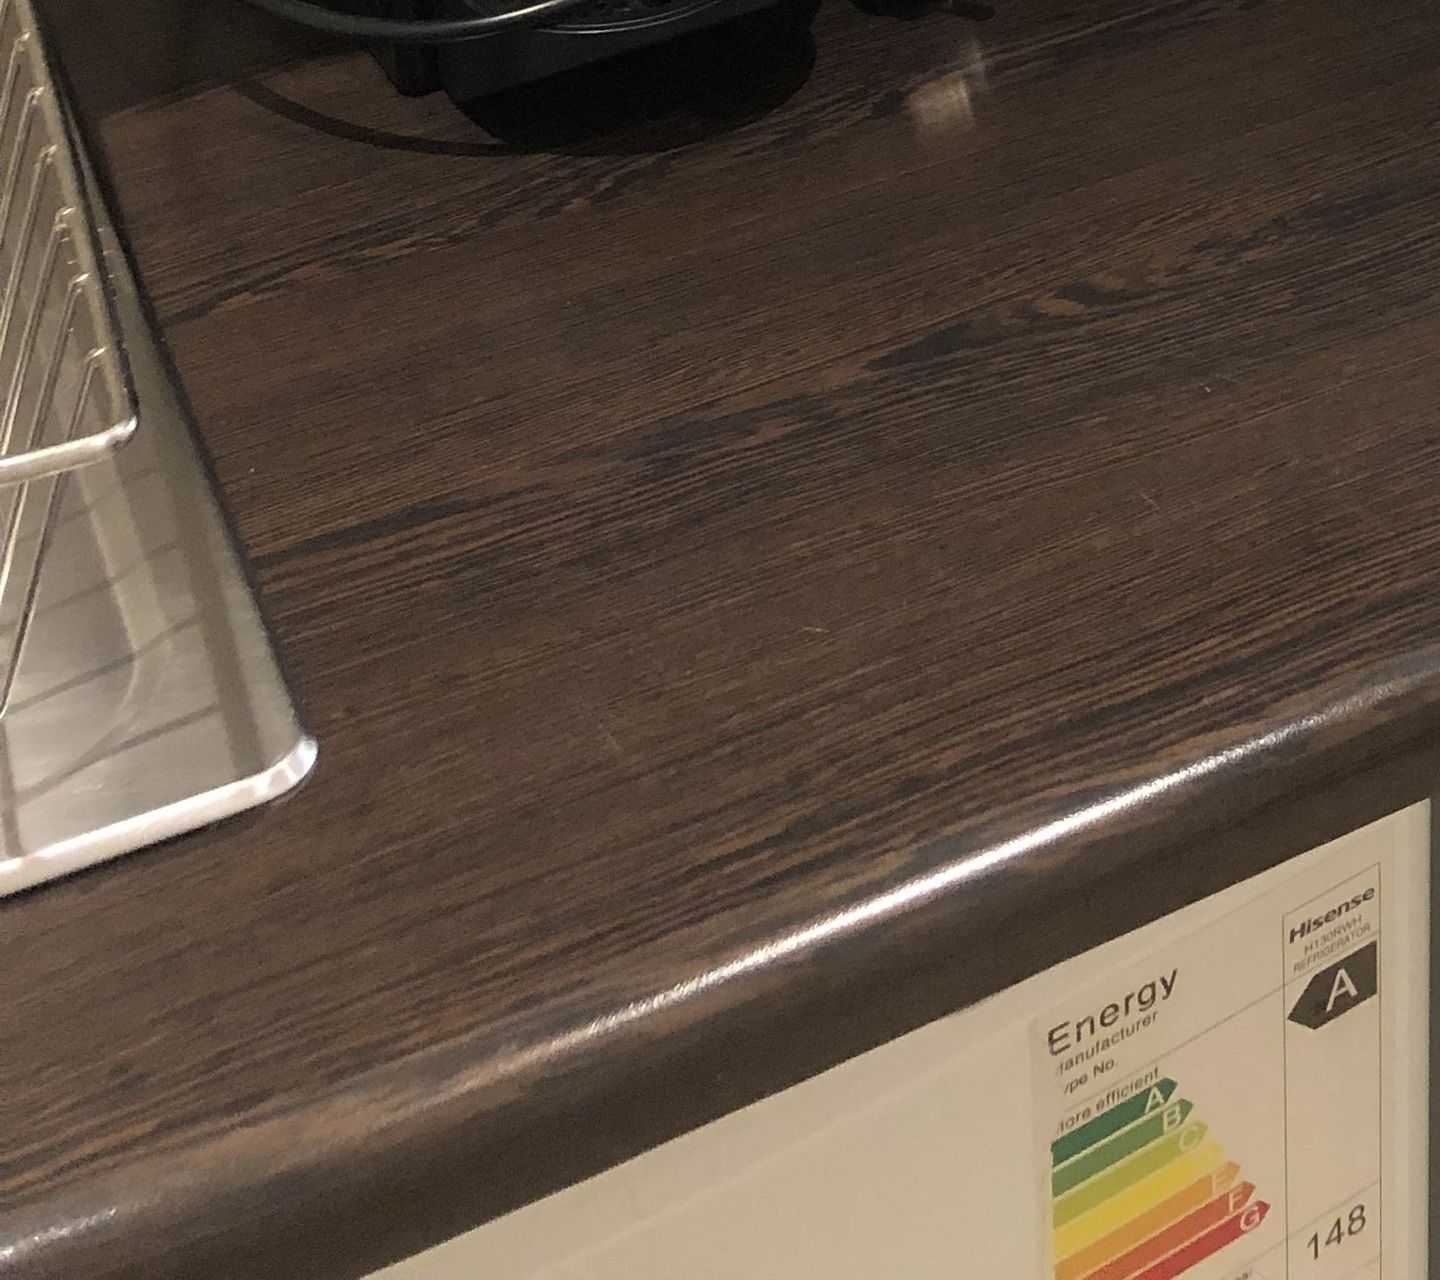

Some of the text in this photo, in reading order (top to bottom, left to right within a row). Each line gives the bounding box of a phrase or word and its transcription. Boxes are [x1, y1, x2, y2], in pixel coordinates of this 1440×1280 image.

[1288, 887, 1375, 944] Hisense
[1293, 923, 1371, 973] REFRIGERATOR
[1047, 968, 1178, 1056] Energy
[1325, 969, 1359, 1011] A
[1095, 1066, 1158, 1112] efficient
[1145, 1087, 1165, 1114] A
[1163, 1103, 1182, 1133] B
[1229, 1191, 1243, 1214] F
[1240, 1205, 1261, 1230] G
[1306, 1203, 1367, 1260] 148
